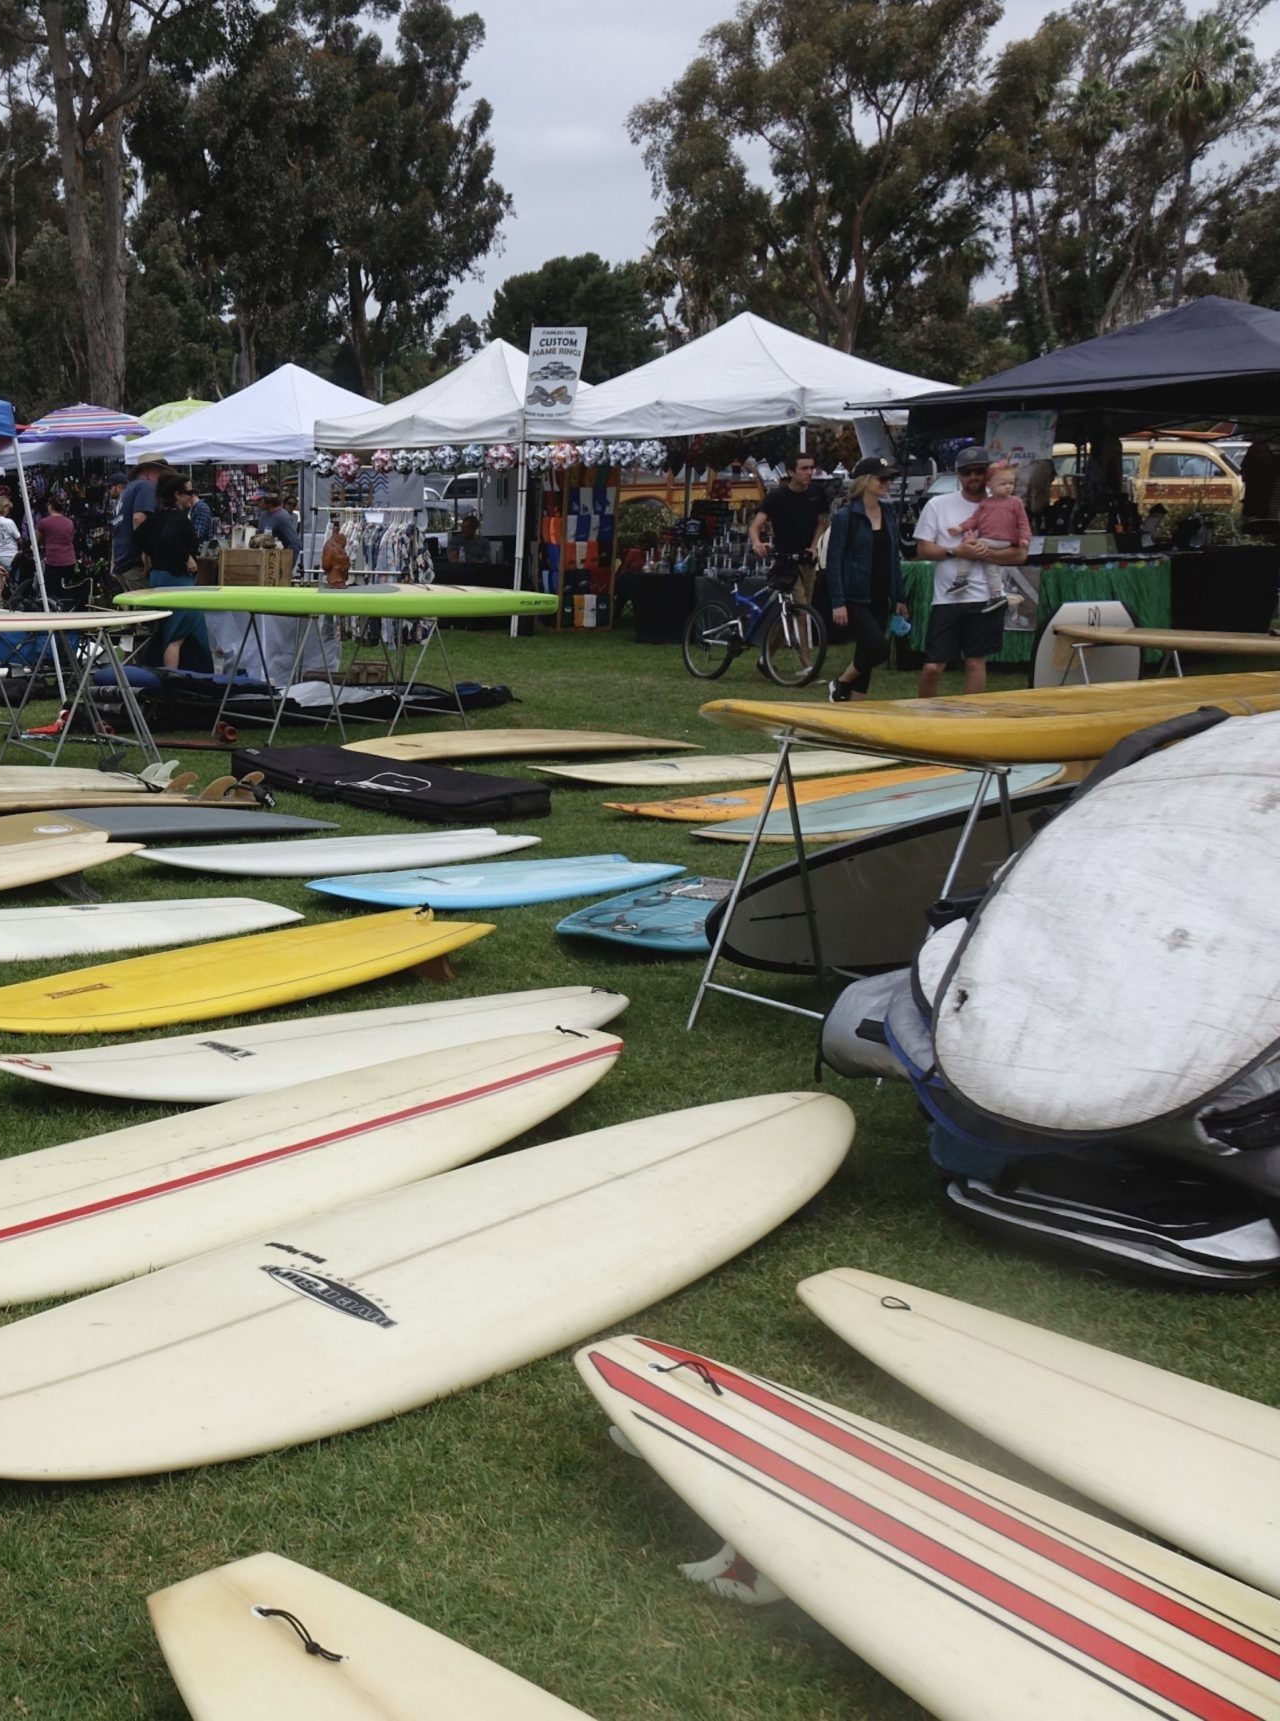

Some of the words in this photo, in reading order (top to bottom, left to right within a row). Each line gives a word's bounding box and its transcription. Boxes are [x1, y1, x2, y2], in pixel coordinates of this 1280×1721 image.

[539, 338, 578, 348] CUSTOM
[532, 347, 557, 358] NAME
[559, 347, 582, 357] RINGS
